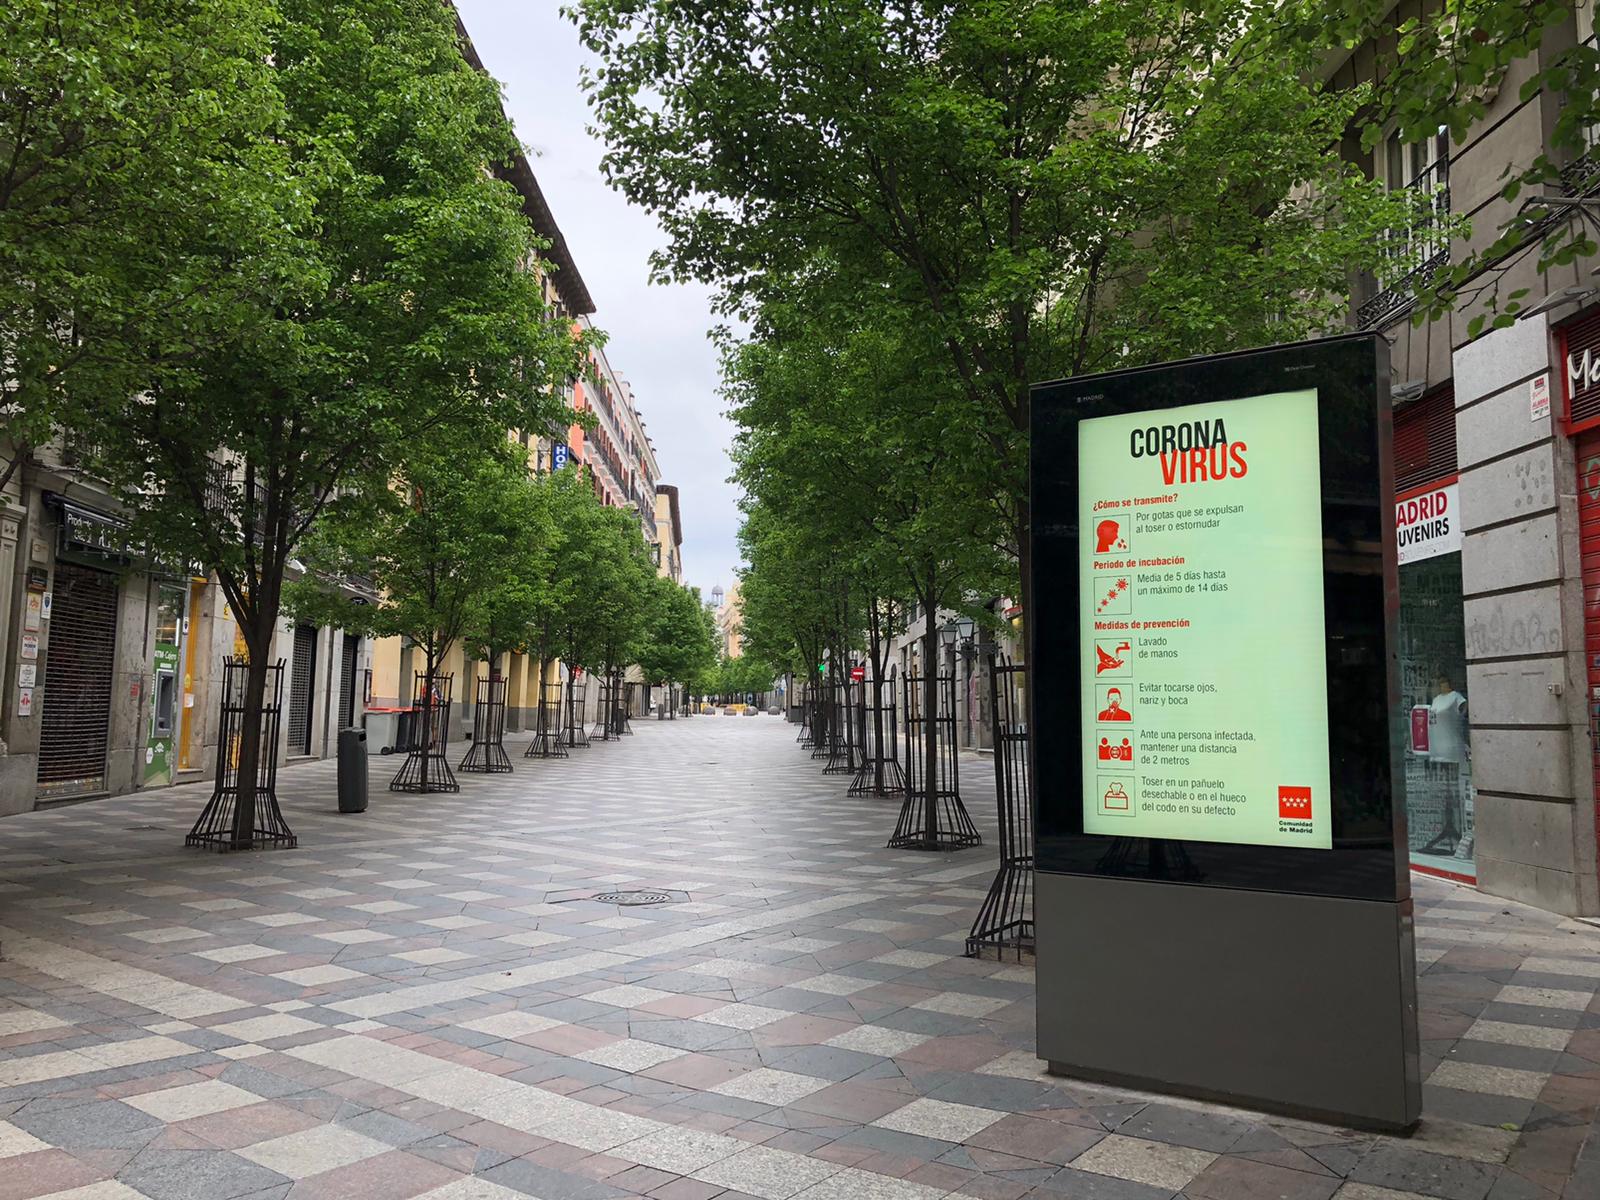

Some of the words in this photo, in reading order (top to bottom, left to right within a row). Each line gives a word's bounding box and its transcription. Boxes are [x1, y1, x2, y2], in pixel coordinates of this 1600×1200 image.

[1130, 418, 1227, 458] CORONA
[1159, 441, 1248, 485] VIRUS
[1092, 501, 1120, 512] ¿Cómo
[1121, 499, 1132, 508] se
[1133, 493, 1179, 505] transmite?
[1396, 491, 1448, 528] ADRID
[1135, 511, 1150, 522] Por
[1151, 511, 1175, 522] gotas
[1176, 509, 1192, 520] que
[1193, 508, 1204, 517] se
[1205, 505, 1244, 516] expulsan
[1135, 524, 1144, 534] al
[1145, 524, 1166, 533] toser
[1167, 523, 1174, 532] o
[1175, 519, 1221, 531] estornudar
[1398, 517, 1450, 548] UVENIRS
[1093, 559, 1125, 570] Periodo
[1125, 558, 1137, 568] de
[1138, 555, 1185, 567] incubación
[1137, 573, 1162, 583] Media
[1163, 572, 1174, 582] de
[1175, 571, 1182, 582] 5
[1183, 570, 1202, 581] días
[1203, 570, 1226, 580] hasta
[1137, 587, 1148, 596] un
[1149, 584, 1183, 595] máximo
[1184, 583, 1195, 594] de
[1197, 583, 1208, 593] 14
[1210, 582, 1229, 592] días
[1094, 620, 1129, 630] Medidas
[1130, 620, 1142, 629] de
[1143, 618, 1190, 631] prevención
[1138, 636, 1168, 647] Lavado
[1138, 649, 1149, 659] de
[1150, 650, 1179, 658] manos
[1139, 682, 1162, 693] Evitar
[1163, 683, 1195, 693] tocarse
[1196, 682, 1218, 694] ojos,
[1139, 695, 1160, 705] nariz
[1160, 697, 1167, 707] y
[1168, 695, 1189, 705] boca
[1139, 729, 1159, 739] Ante
[1160, 731, 1176, 740] una
[1177, 731, 1212, 741] persona
[1214, 730, 1256, 742] infectada,
[1140, 743, 1179, 753] mantener
[1181, 744, 1197, 753] una
[1198, 743, 1238, 754] distancia
[1140, 754, 1151, 765] de
[1152, 754, 1158, 765] 2
[1160, 756, 1190, 766] metros
[1141, 776, 1164, 787] Toser
[1165, 778, 1176, 787] en
[1177, 779, 1189, 788] un
[1190, 777, 1225, 790] pañuelo
[1141, 789, 1188, 801] desechable
[1189, 792, 1195, 801] o
[1197, 792, 1208, 801] en
[1209, 792, 1218, 802] el
[1219, 792, 1247, 803] hueco
[1141, 802, 1155, 812] del
[1156, 803, 1177, 813] codo
[1178, 805, 1190, 814] en
[1191, 805, 1202, 815] su
[1203, 804, 1236, 816] defecto
